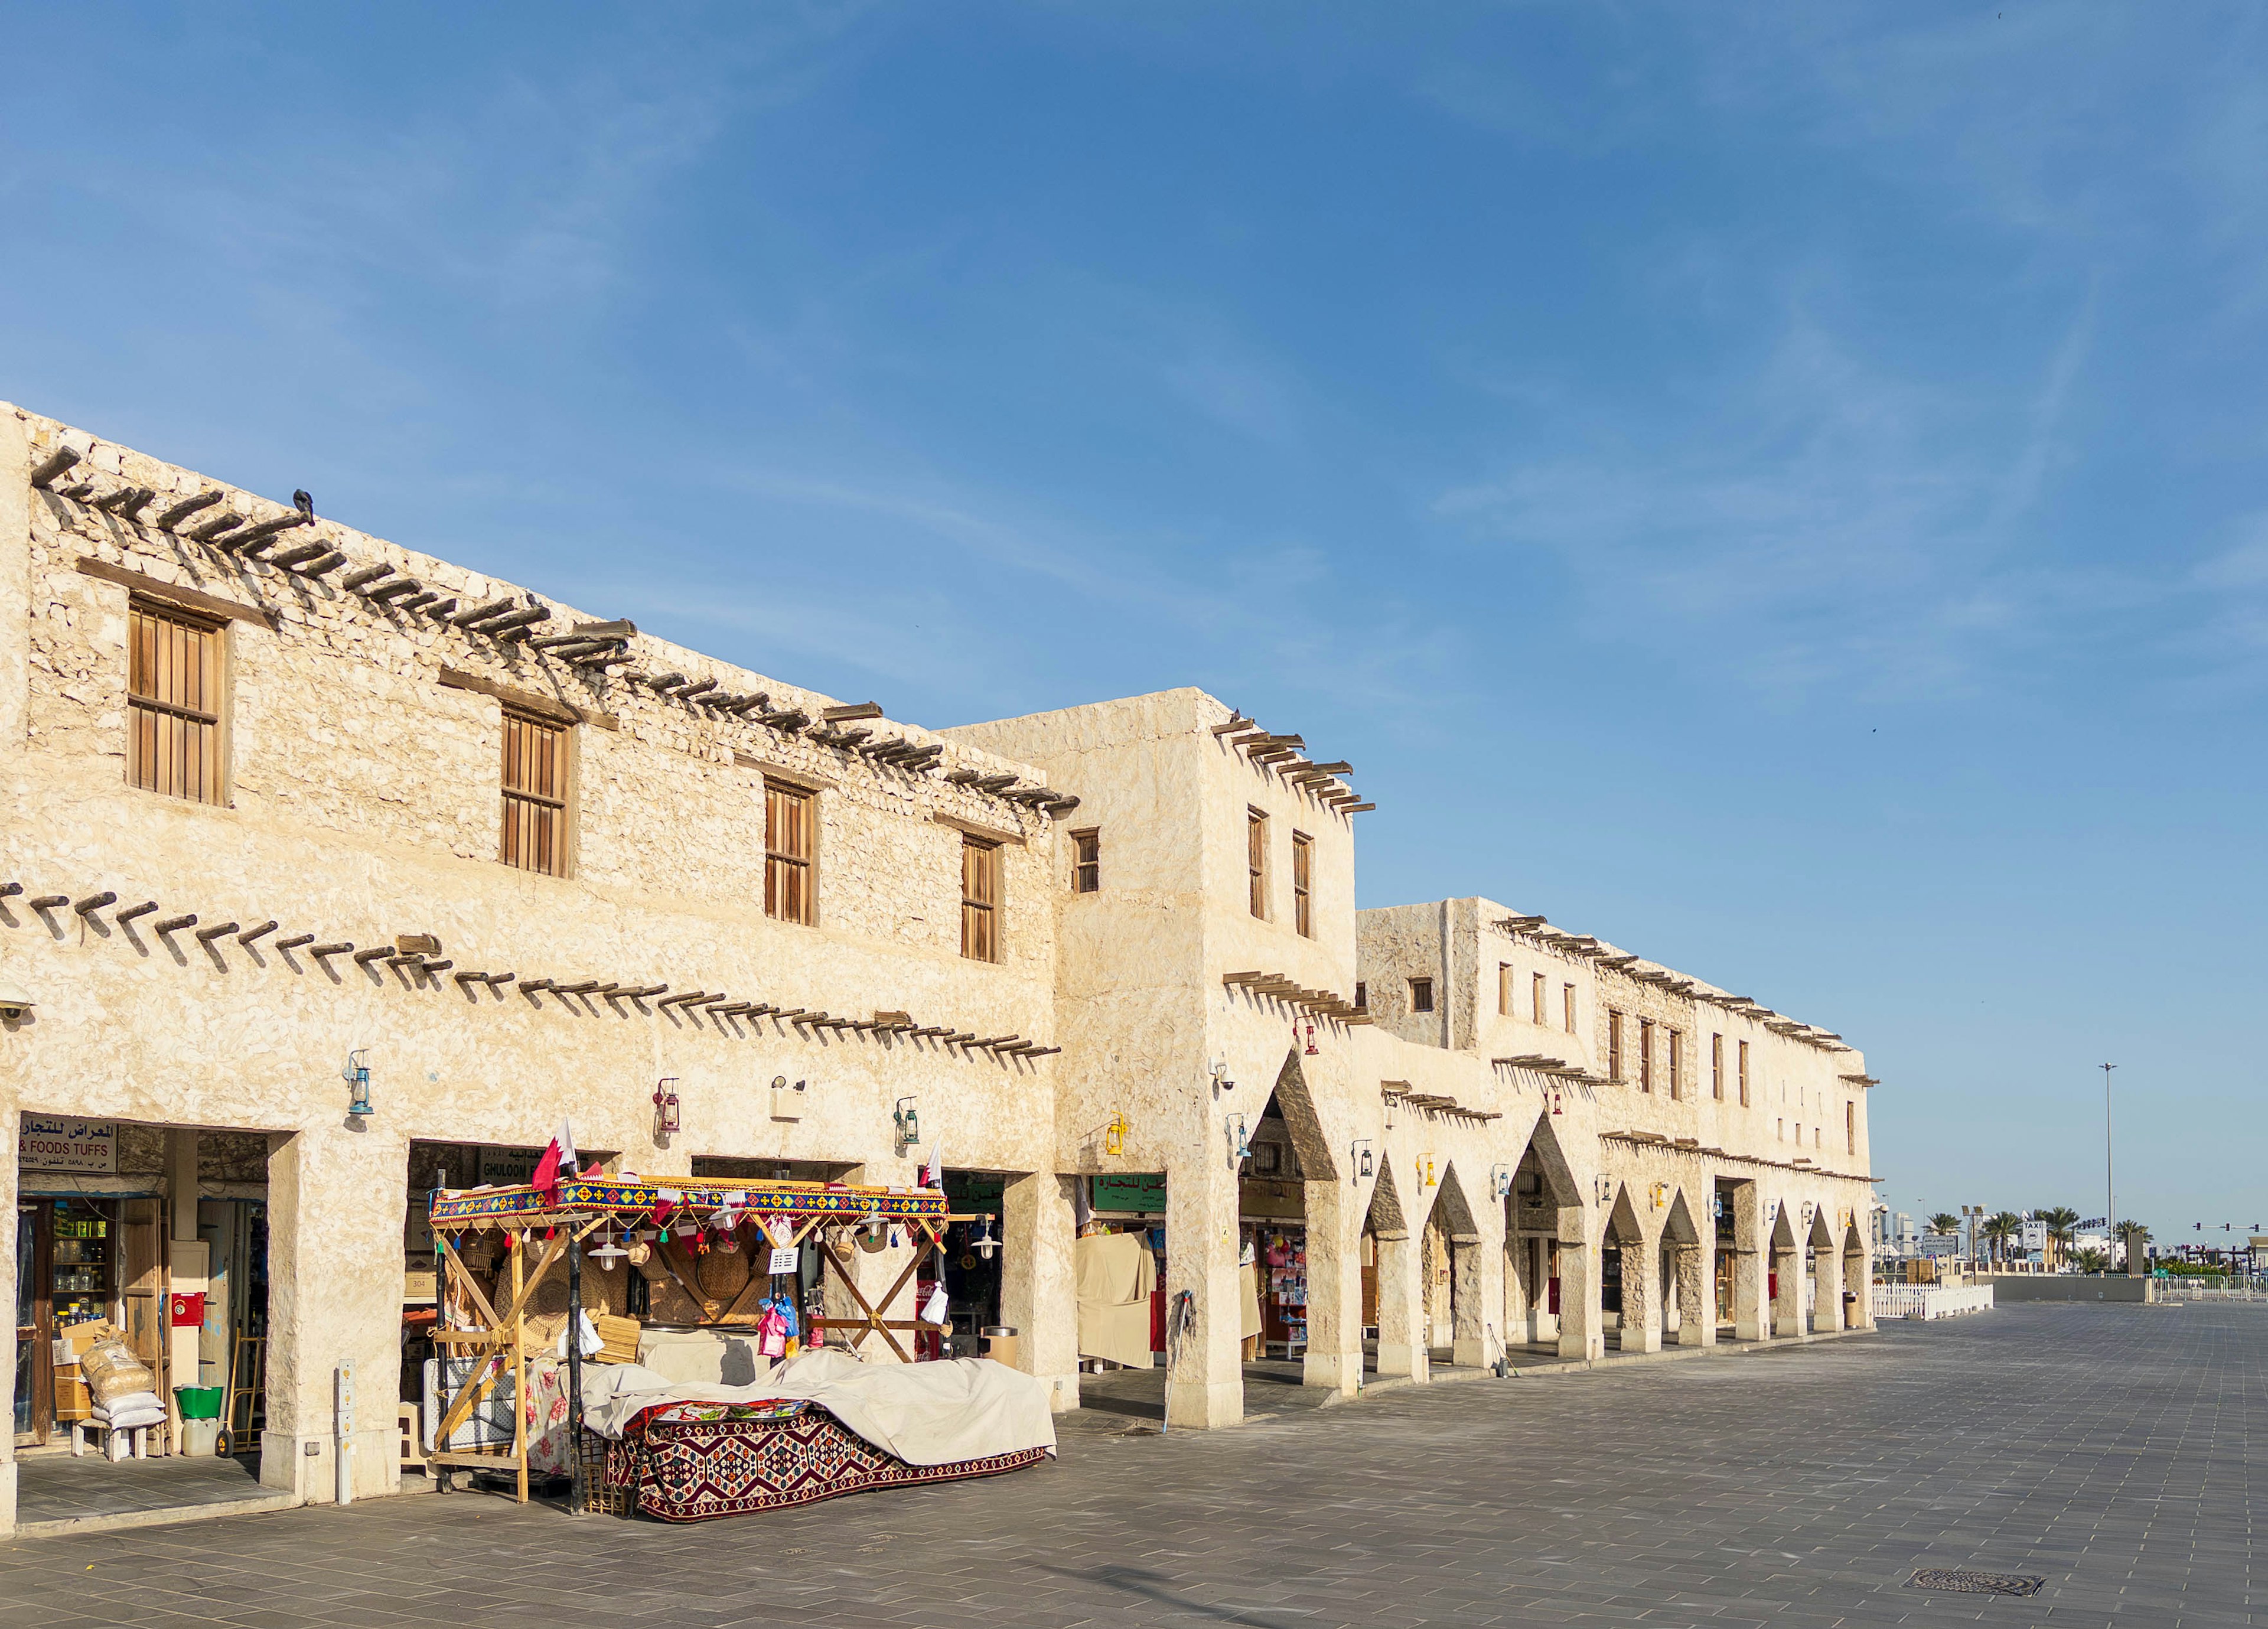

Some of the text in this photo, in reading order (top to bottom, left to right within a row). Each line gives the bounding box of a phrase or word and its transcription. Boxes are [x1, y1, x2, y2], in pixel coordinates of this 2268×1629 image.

[30, 1140, 70, 1155] FOODS
[74, 1143, 108, 1157] TUFFS
[484, 1162, 526, 1178] GHULOOM
